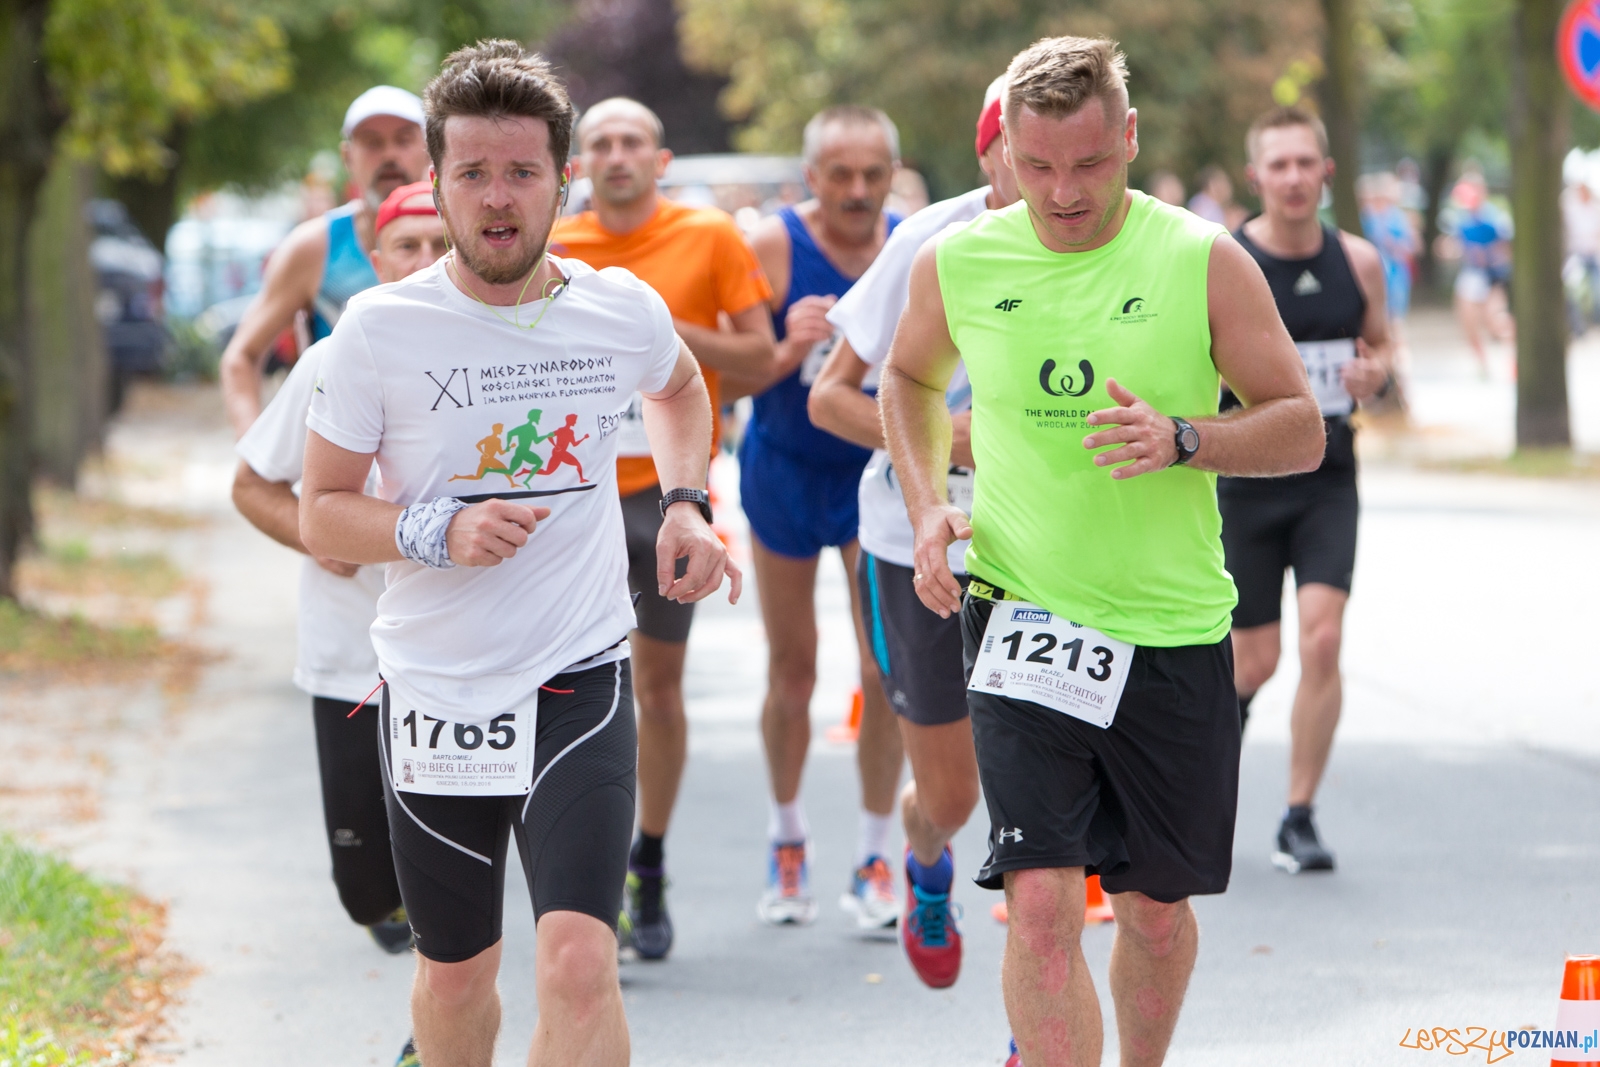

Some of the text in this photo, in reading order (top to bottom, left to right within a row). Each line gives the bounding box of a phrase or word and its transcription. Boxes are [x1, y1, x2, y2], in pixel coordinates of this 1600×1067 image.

[994, 299, 1023, 312] 4F
[424, 367, 474, 411] XI
[481, 373, 616, 393] KOŚCIAŃSKI PÓŁMARATON
[499, 393, 517, 403] DRA
[518, 390, 558, 401] HENRYKA
[559, 385, 616, 398] FLORKOWSKIEGO
[1025, 409, 1042, 417] THE
[1044, 409, 1078, 418] WORLD
[1036, 421, 1078, 429] WROCŁAW
[1001, 630, 1114, 682] 1213
[1040, 668, 1064, 678] BŁAŻEJ
[1009, 672, 1107, 705] 39 BIEG LECHITÓW
[403, 710, 516, 750] 1765
[416, 761, 518, 773] 39 BIEG LECHITÓW
